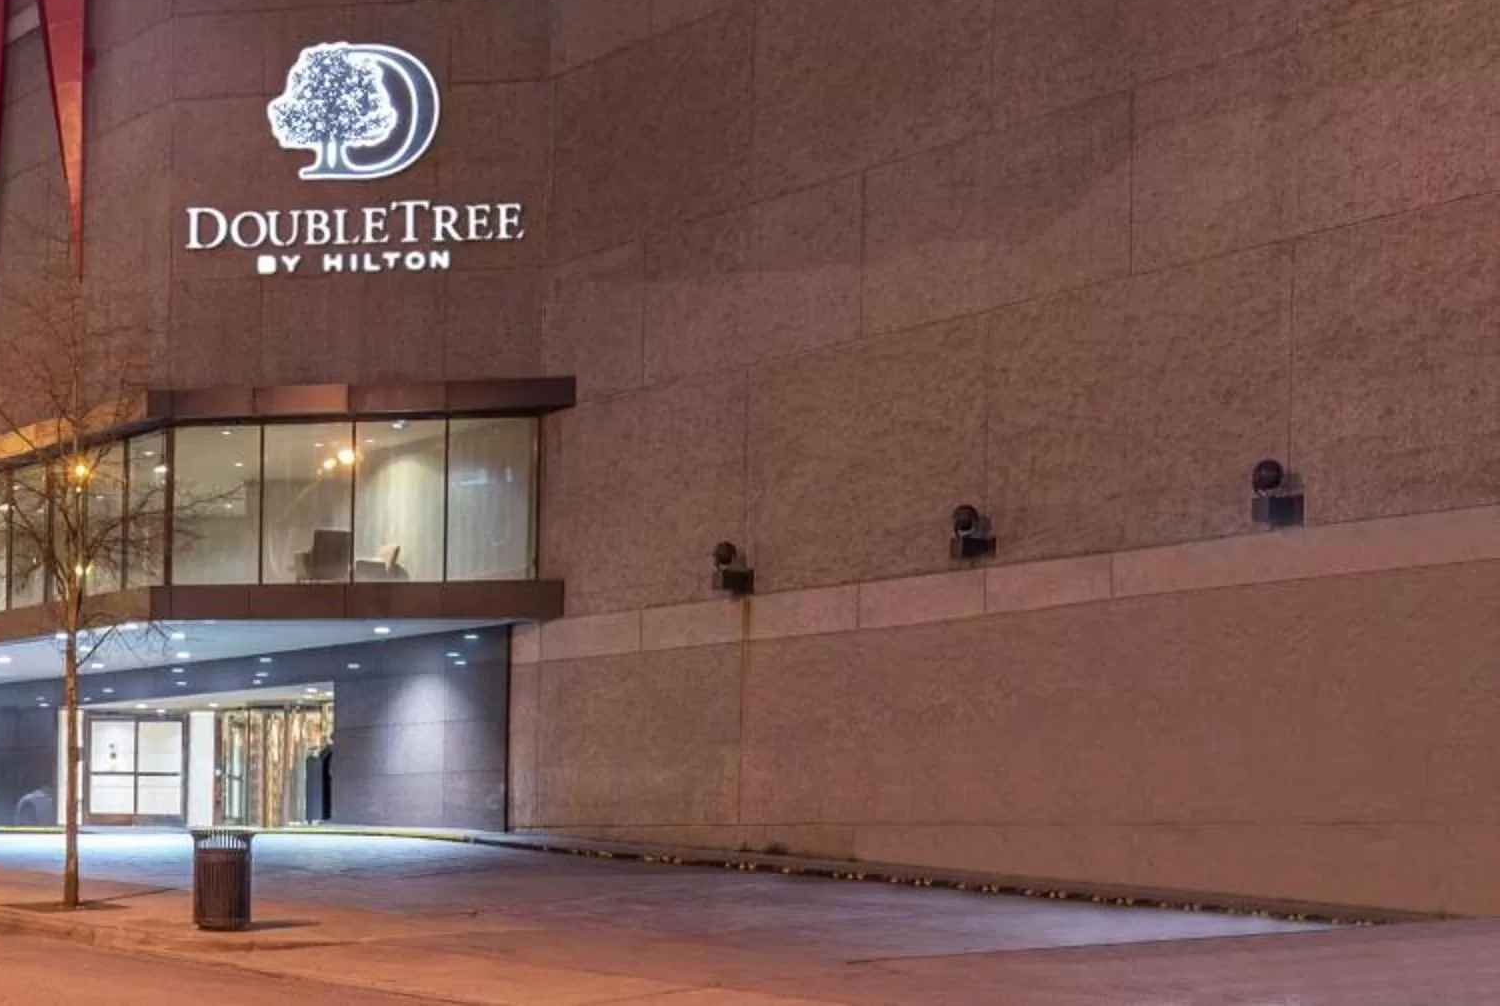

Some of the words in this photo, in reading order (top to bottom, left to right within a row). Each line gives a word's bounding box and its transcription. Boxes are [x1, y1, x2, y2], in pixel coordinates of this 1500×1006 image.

[185, 200, 524, 251] DOUBLETREE
[257, 253, 301, 275] BY
[322, 250, 451, 274] HILTON
